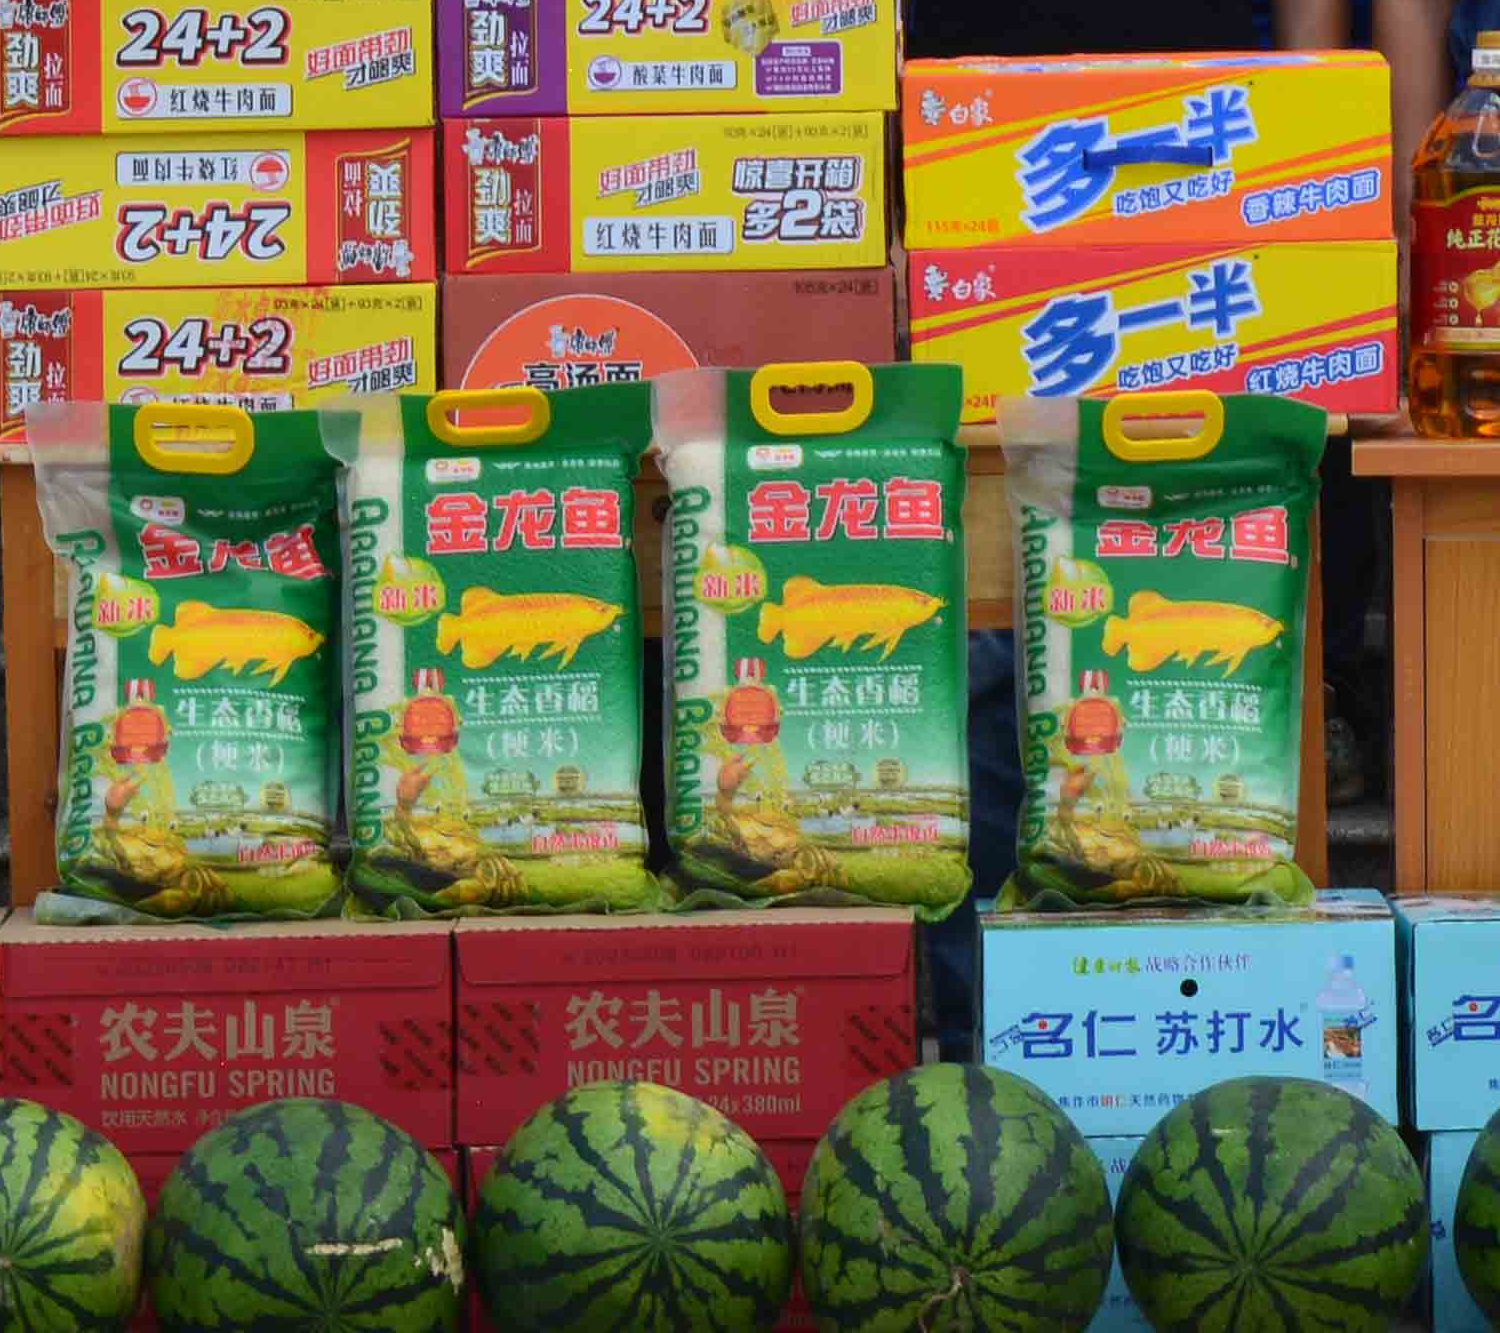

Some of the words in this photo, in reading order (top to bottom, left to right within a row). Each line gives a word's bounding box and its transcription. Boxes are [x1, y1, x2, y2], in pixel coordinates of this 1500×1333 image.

[116, 5, 293, 69] 24+2
[471, 11, 506, 86] 劲爽
[510, 31, 529, 87] 拉面
[4, 32, 40, 106] 劲爽
[44, 52, 64, 108] 拉面
[632, 62, 726, 86] 酸菜牛肉面
[169, 87, 278, 113] 红烧牛肉面
[131, 156, 239, 182] 红烧牛肉面
[732, 157, 862, 193] 惊喜开箱
[1016, 85, 1257, 230] 多一半
[343, 162, 362, 217] 拉面
[365, 160, 402, 239] 劲爽
[474, 167, 512, 245] 劲爽
[515, 189, 534, 243] 拉面
[742, 190, 864, 240] 多2袋
[1113, 171, 1234, 216] 吃饱又吃好
[1244, 170, 1379, 225] 香辣牛肉面
[116, 203, 293, 263] 24+2
[595, 222, 719, 250] 红烧牛肉面
[118, 316, 293, 377] 24+2
[1021, 259, 1261, 397] 多一半
[6, 340, 42, 414] 劲爽
[1117, 346, 1236, 388] 吃饱又吃好
[1246, 344, 1383, 395] 红烧牛肉面
[425, 487, 623, 555] 金龙鱼
[748, 478, 944, 543] 金龙鱼
[100, 1000, 335, 1062] 农夫山泉
[564, 988, 800, 1049] 农夫山泉
[1022, 1010, 1136, 1059] 名仁
[1155, 1007, 1304, 1054] 苏打水
[100, 1070, 217, 1100] NONGFU
[228, 1068, 335, 1098] SPRING
[694, 1057, 800, 1085] SPRING
